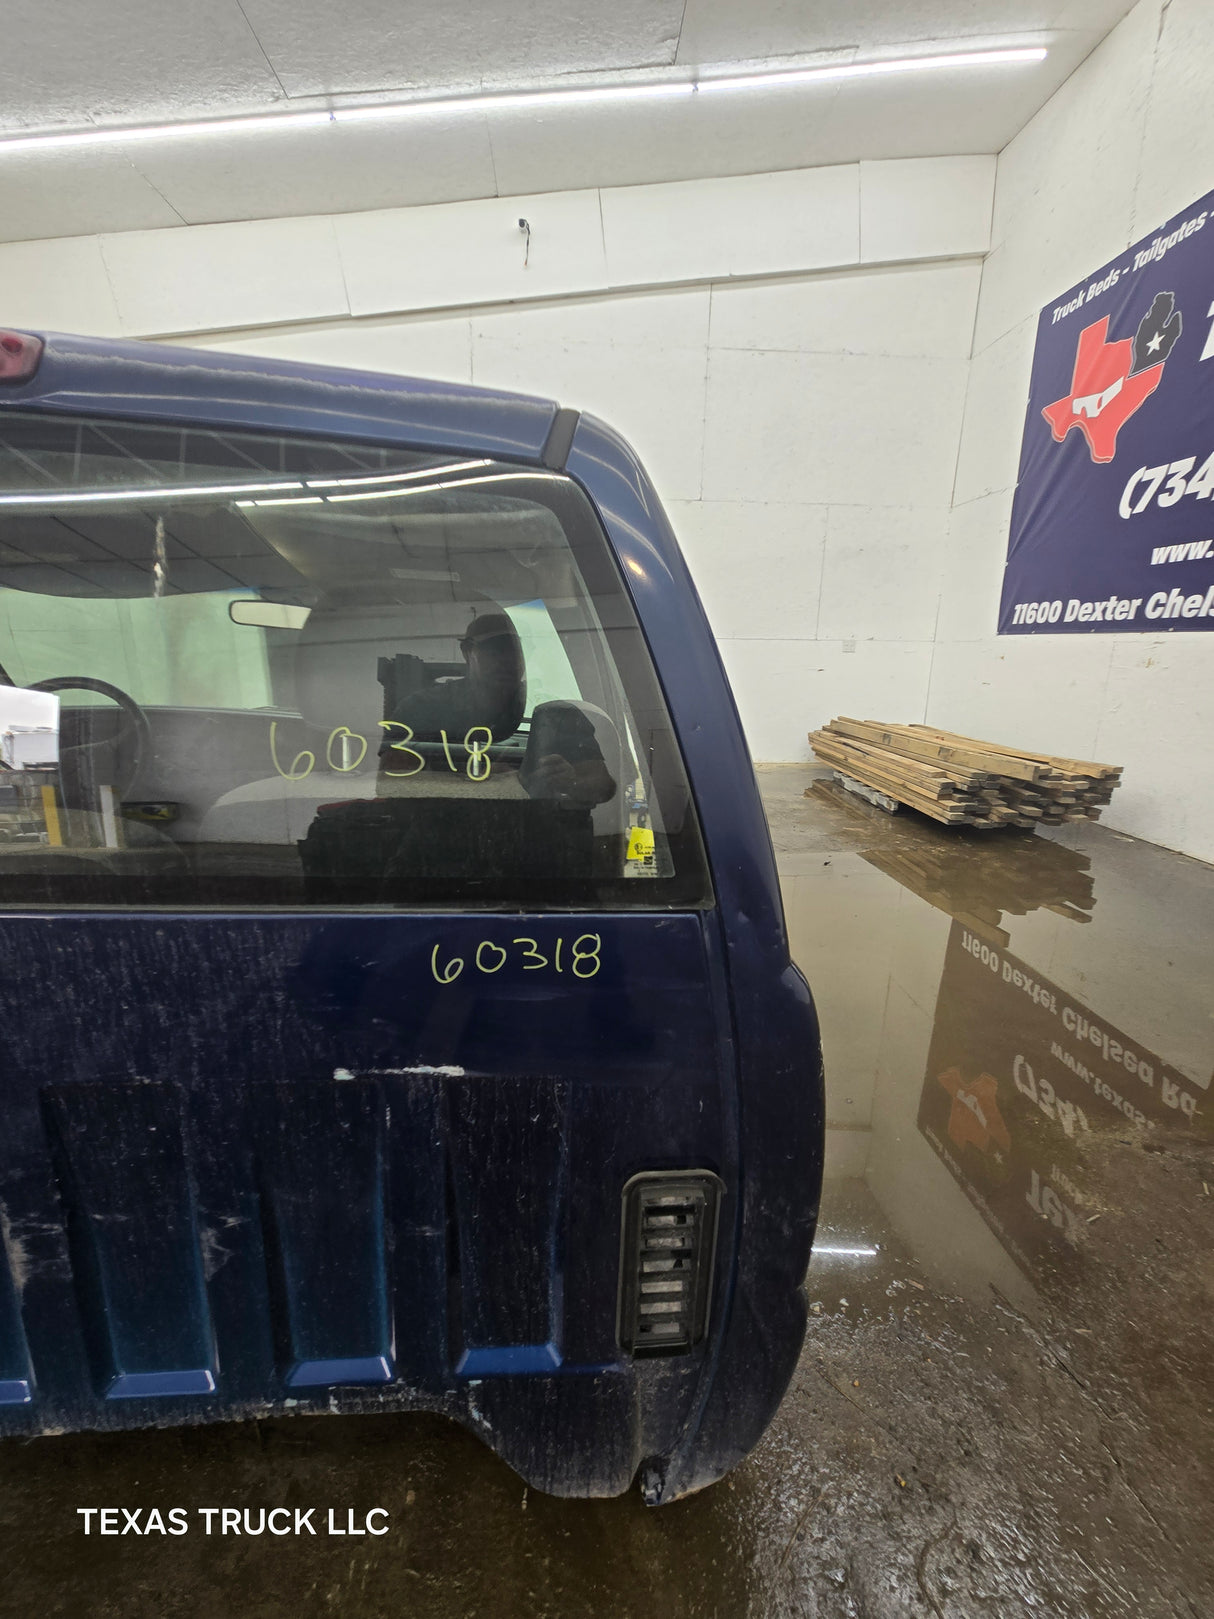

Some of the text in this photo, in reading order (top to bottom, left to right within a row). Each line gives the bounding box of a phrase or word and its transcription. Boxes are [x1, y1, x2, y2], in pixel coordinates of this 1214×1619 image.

[1051, 290, 1086, 325] Truck
[1086, 268, 1121, 303] Beds
[1132, 211, 1209, 272] Tailgates
[1118, 451, 1214, 519] (734
[1012, 601, 1063, 625] 11600
[1063, 595, 1143, 623] Dexter
[270, 719, 493, 781] 60318
[431, 933, 601, 983] 60318
